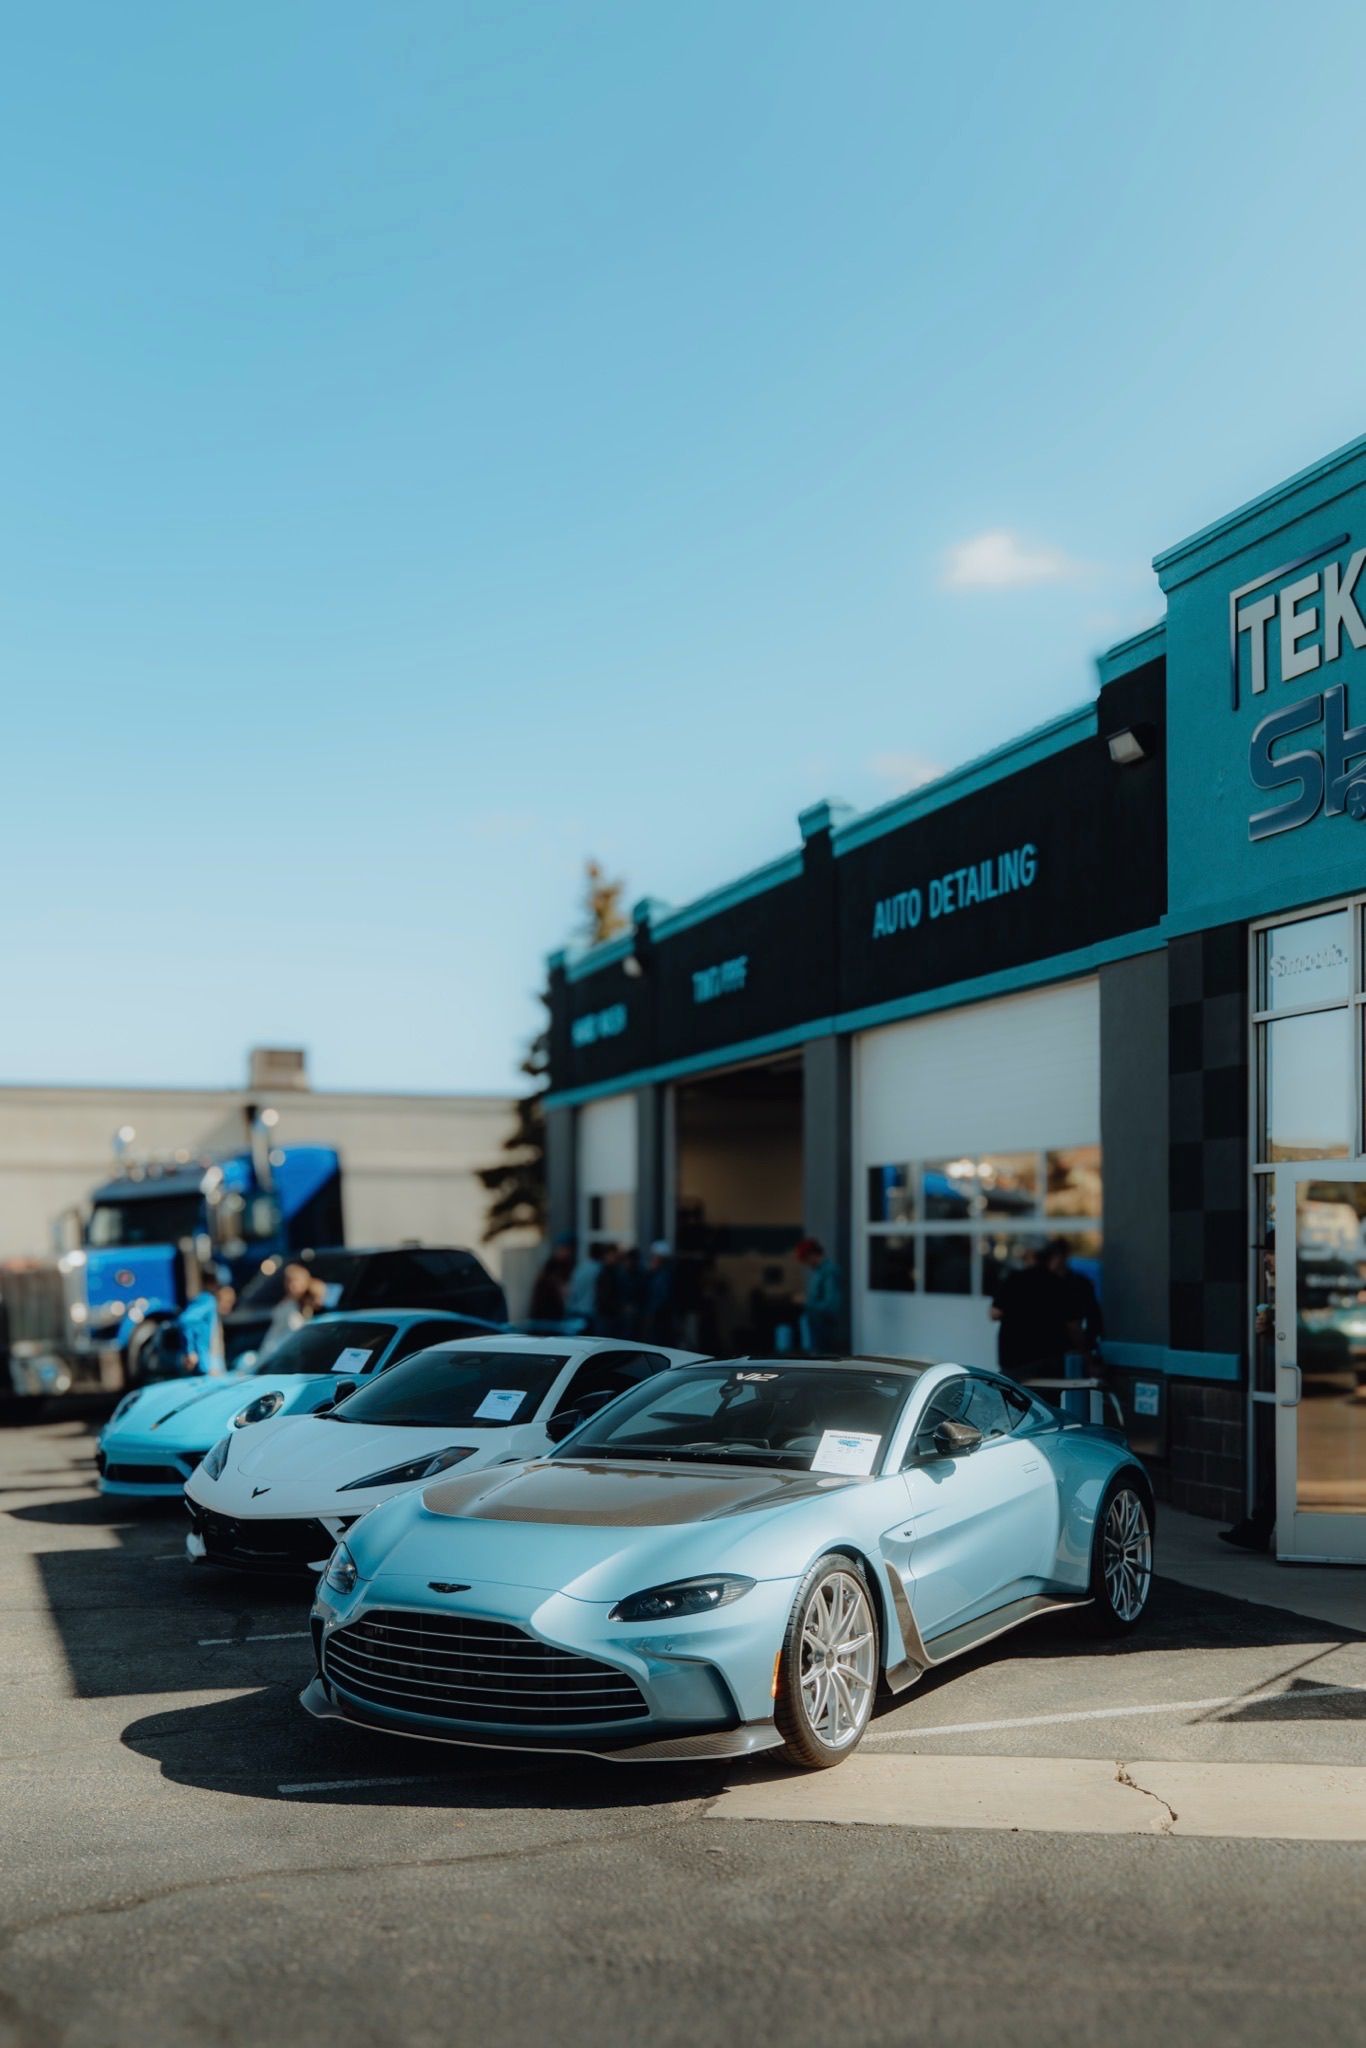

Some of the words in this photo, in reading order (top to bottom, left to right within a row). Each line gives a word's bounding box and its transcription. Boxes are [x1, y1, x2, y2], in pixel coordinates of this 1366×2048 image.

[1238, 548, 1366, 694] TEK
[873, 888, 921, 939] AUTO
[929, 843, 1037, 919] DETAILING
